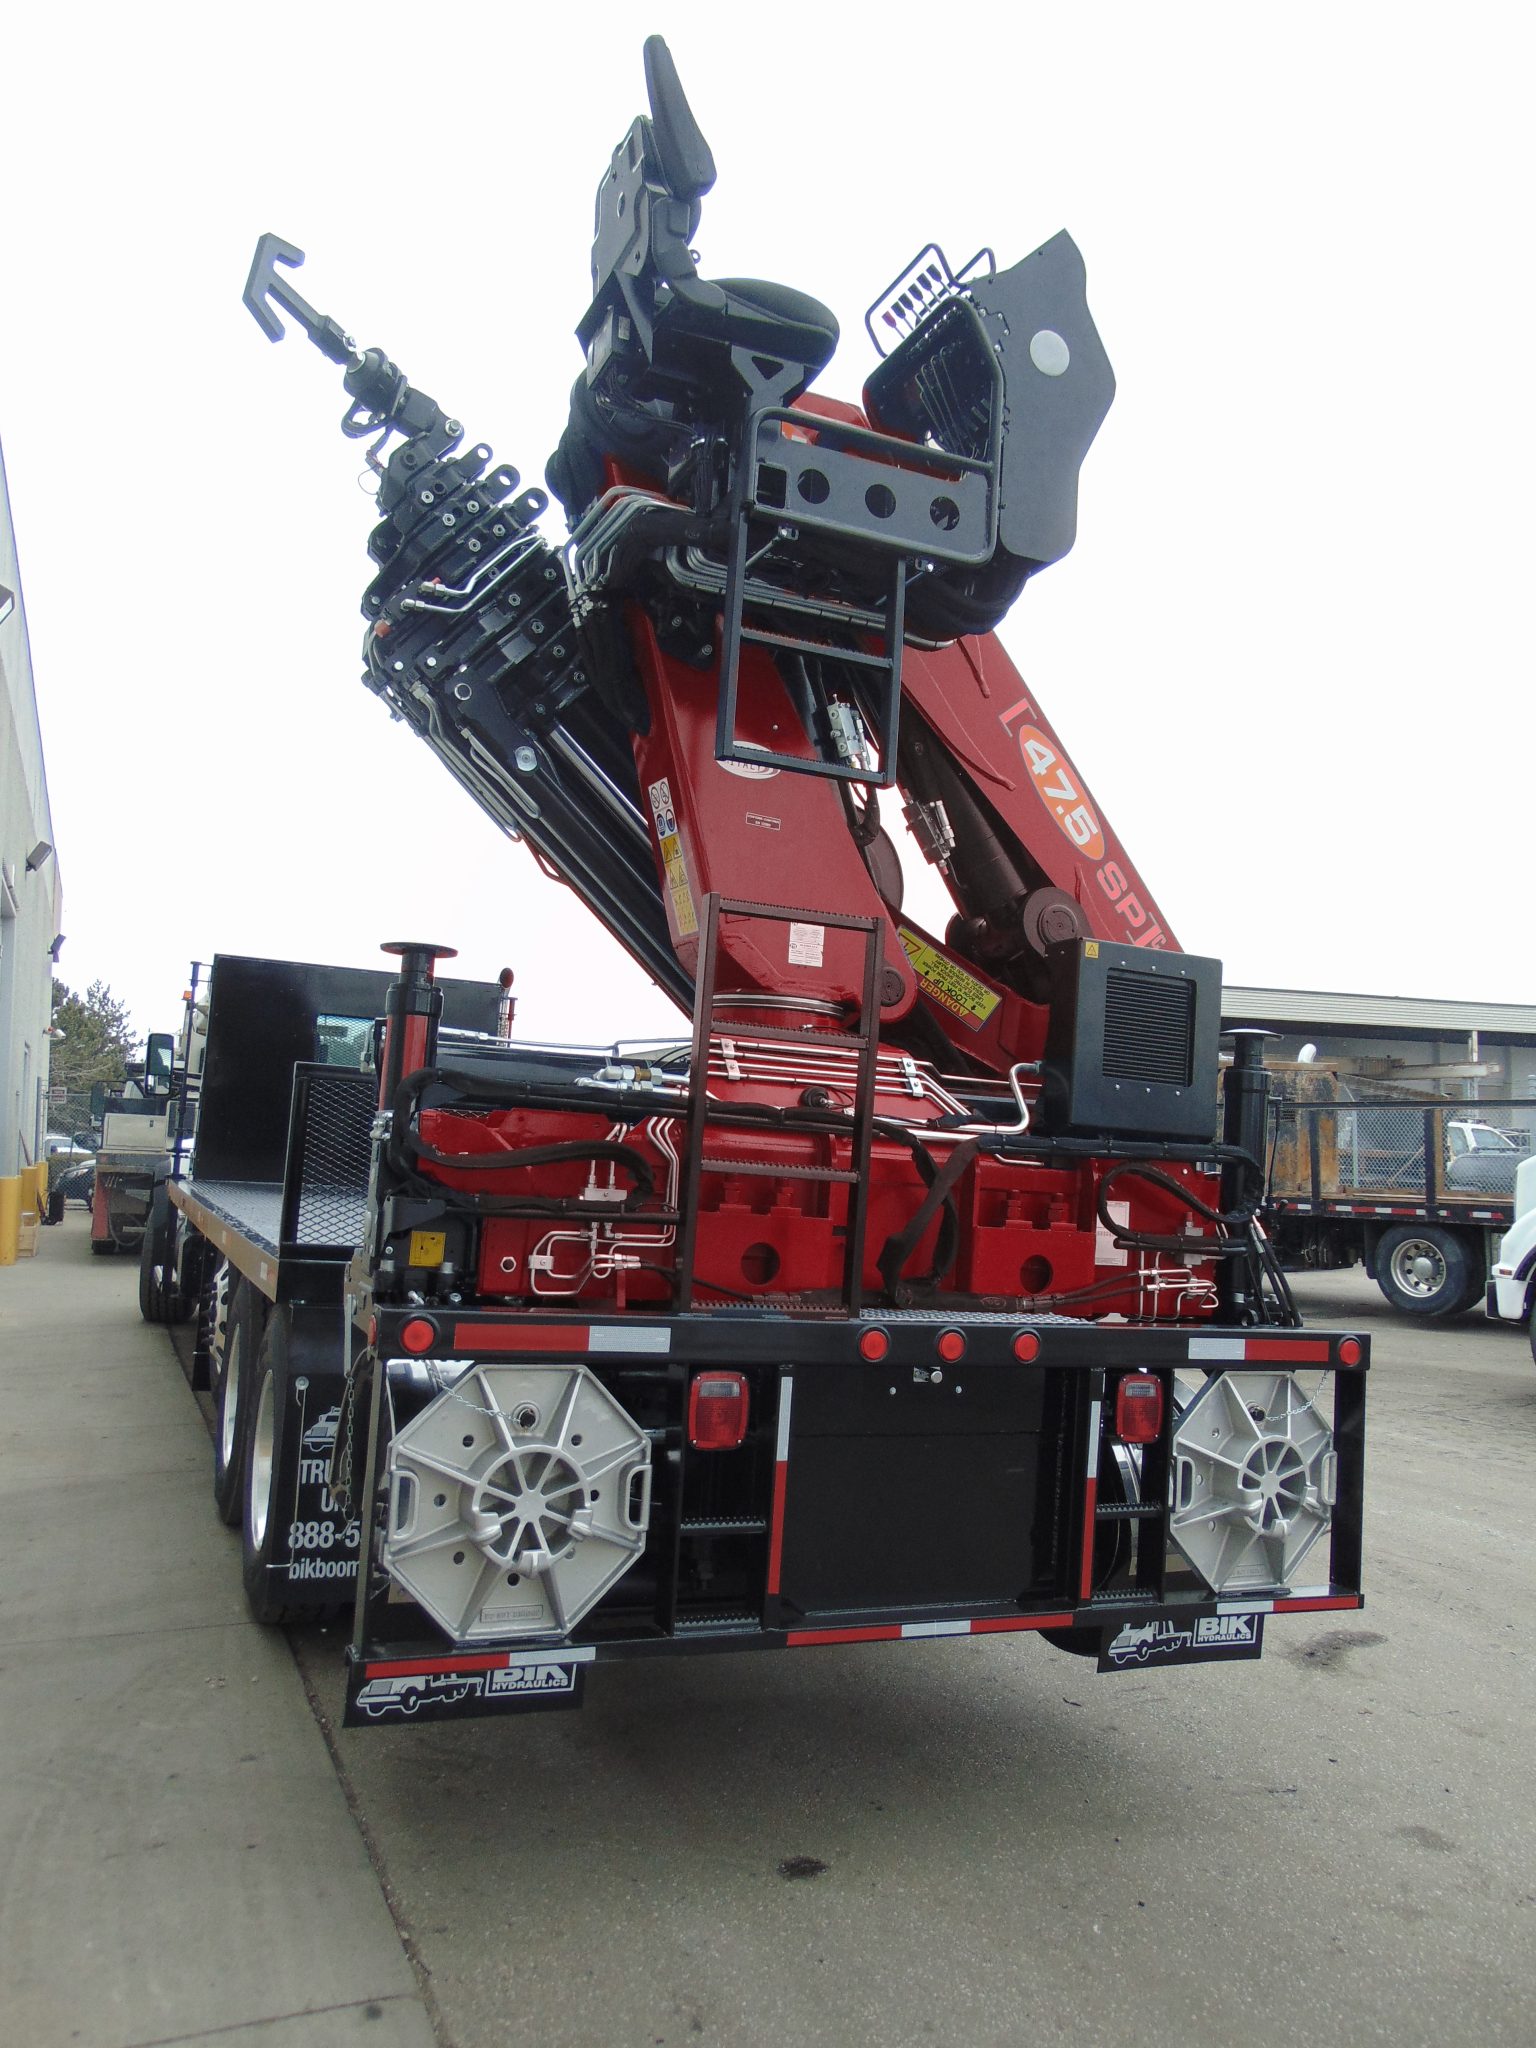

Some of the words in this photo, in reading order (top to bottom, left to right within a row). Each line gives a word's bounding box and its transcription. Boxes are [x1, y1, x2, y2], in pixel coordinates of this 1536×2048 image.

[1024, 739, 1098, 845] 47.5
[935, 953, 949, 965] OTHERS
[935, 959, 948, 969] INJURY
[922, 961, 935, 972] POWER
[930, 961, 939, 969] WILL
[936, 971, 947, 980] FROM
[940, 968, 953, 979] SHOCK
[948, 969, 964, 981] SERIOUS
[933, 978, 944, 987] UP
[948, 980, 957, 988] FEET
[954, 978, 971, 992] ELECTRIC
[971, 980, 983, 989] DEATH
[919, 978, 960, 1010] DANGER
[946, 987, 967, 1004] LOOK
[970, 985, 984, 996] RESULT
[972, 992, 983, 1001] LINES
[1199, 1615, 1251, 1635] BIK
[1198, 1632, 1251, 1642] HYDRAULICS
[492, 1679, 568, 1691] HYDRAULICS
